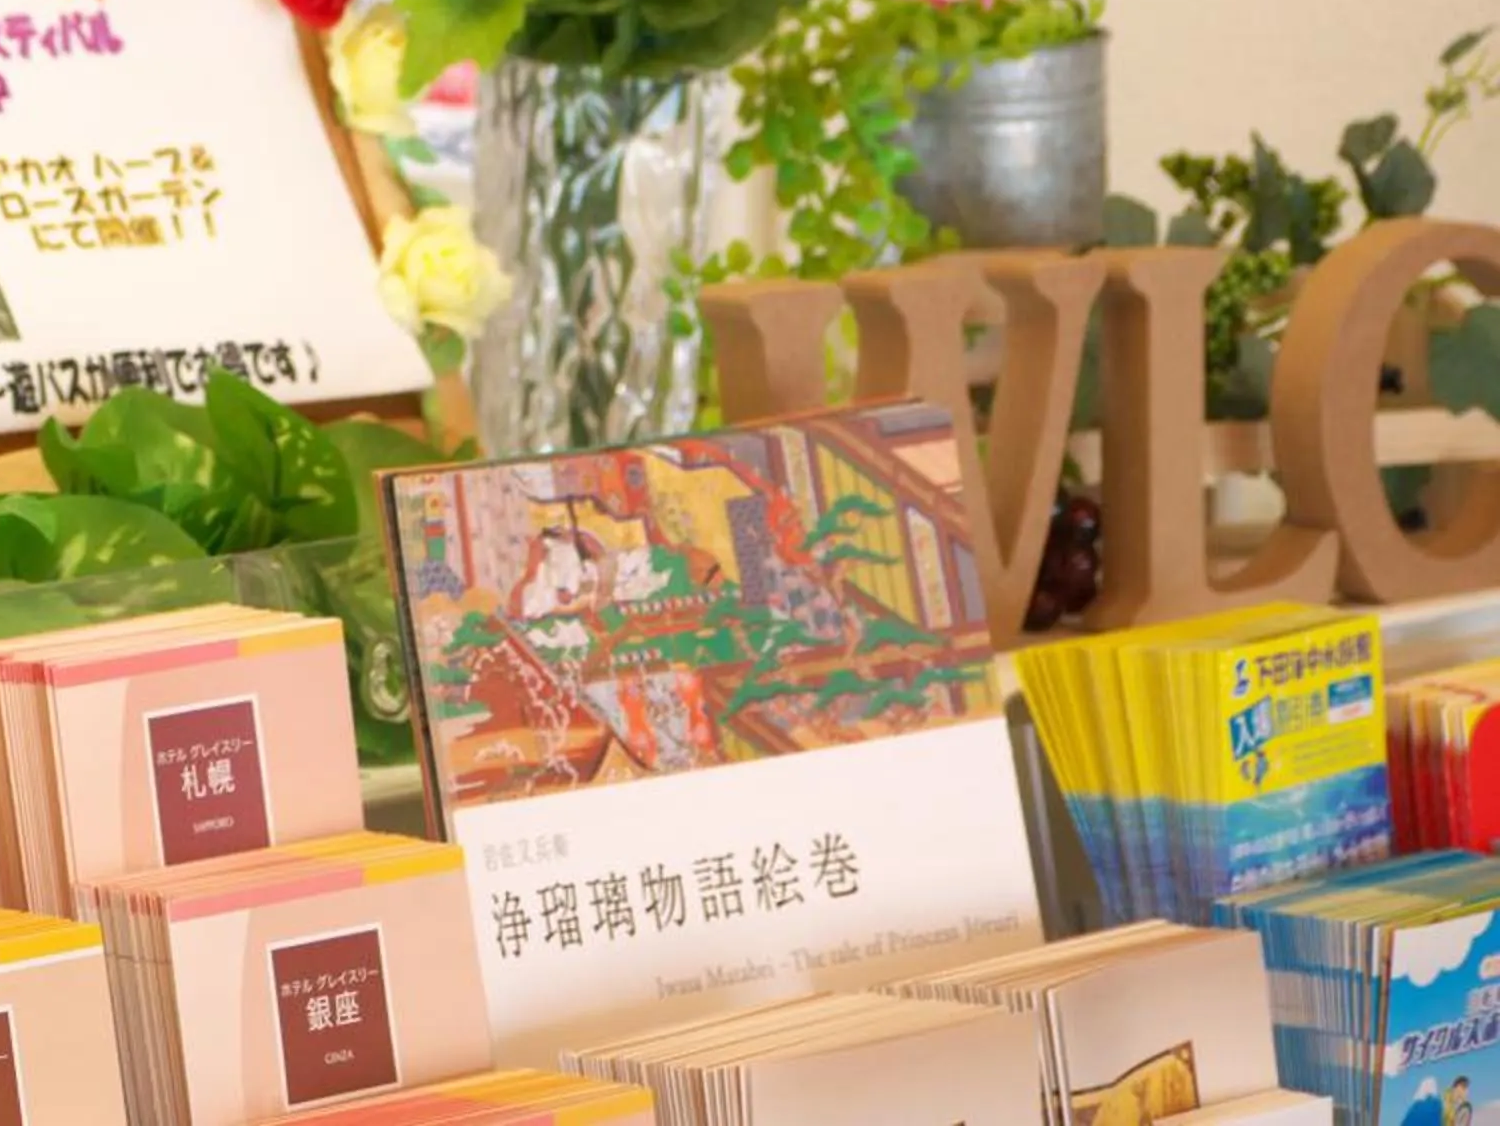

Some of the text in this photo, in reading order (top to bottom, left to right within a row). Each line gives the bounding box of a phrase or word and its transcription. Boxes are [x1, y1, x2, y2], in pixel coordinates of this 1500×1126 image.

[180, 758, 236, 801] 札幌
[490, 831, 863, 960] 浄瑠璃物語絵巻
[305, 990, 363, 1032] 銀座
